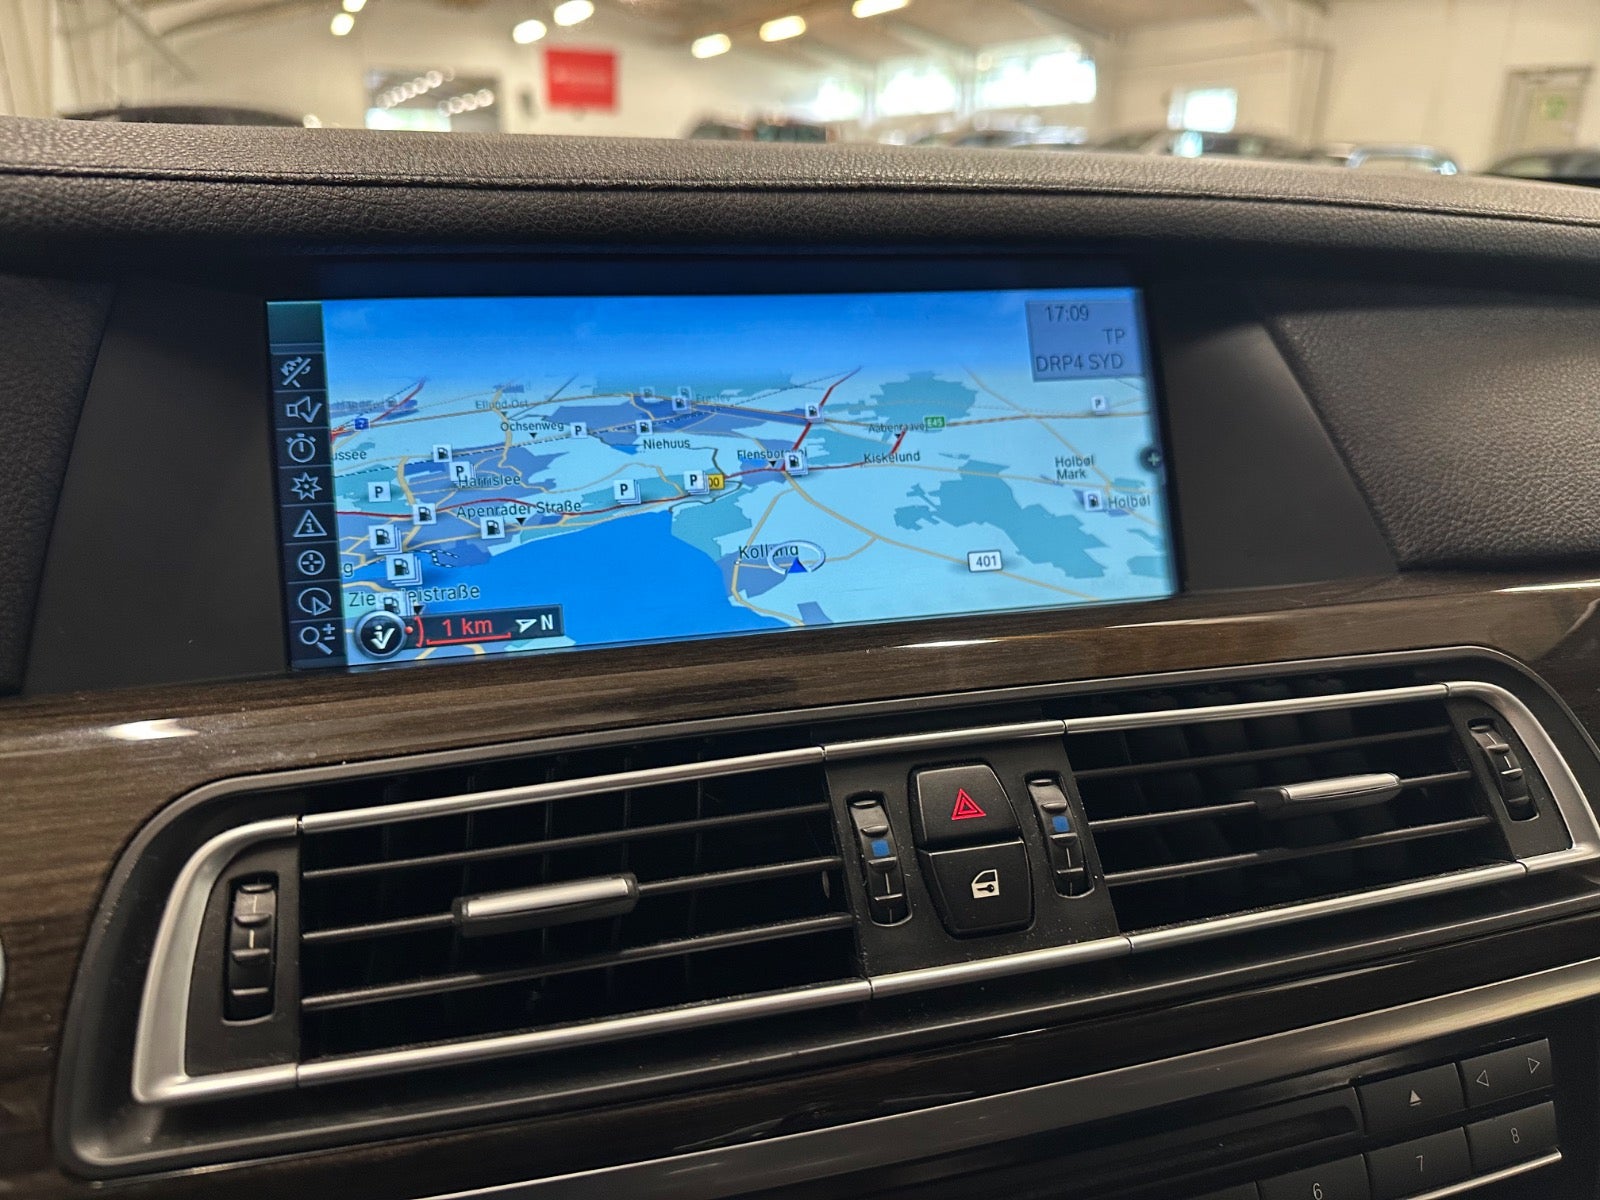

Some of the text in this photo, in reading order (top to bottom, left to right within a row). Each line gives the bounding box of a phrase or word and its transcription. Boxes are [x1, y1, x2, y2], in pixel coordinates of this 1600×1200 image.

[1045, 304, 1089, 322] 17:09
[1102, 328, 1125, 344] TP
[1035, 353, 1124, 373] DRP4 SYD
[500, 422, 564, 432] Ochsenweg
[643, 439, 691, 450] Niehuus
[864, 451, 921, 464] Kiskelund
[1055, 454, 1095, 469] Holbøl
[458, 473, 521, 488] Harrislee
[1056, 468, 1087, 481] Mark
[456, 500, 581, 519] Apenrader Straße
[975, 554, 998, 567] 401
[442, 618, 493, 637] 1 km
[540, 614, 554, 631] N
[1510, 1127, 1520, 1145] 8
[1415, 1155, 1424, 1172] 7
[1312, 1182, 1323, 1200] 6
